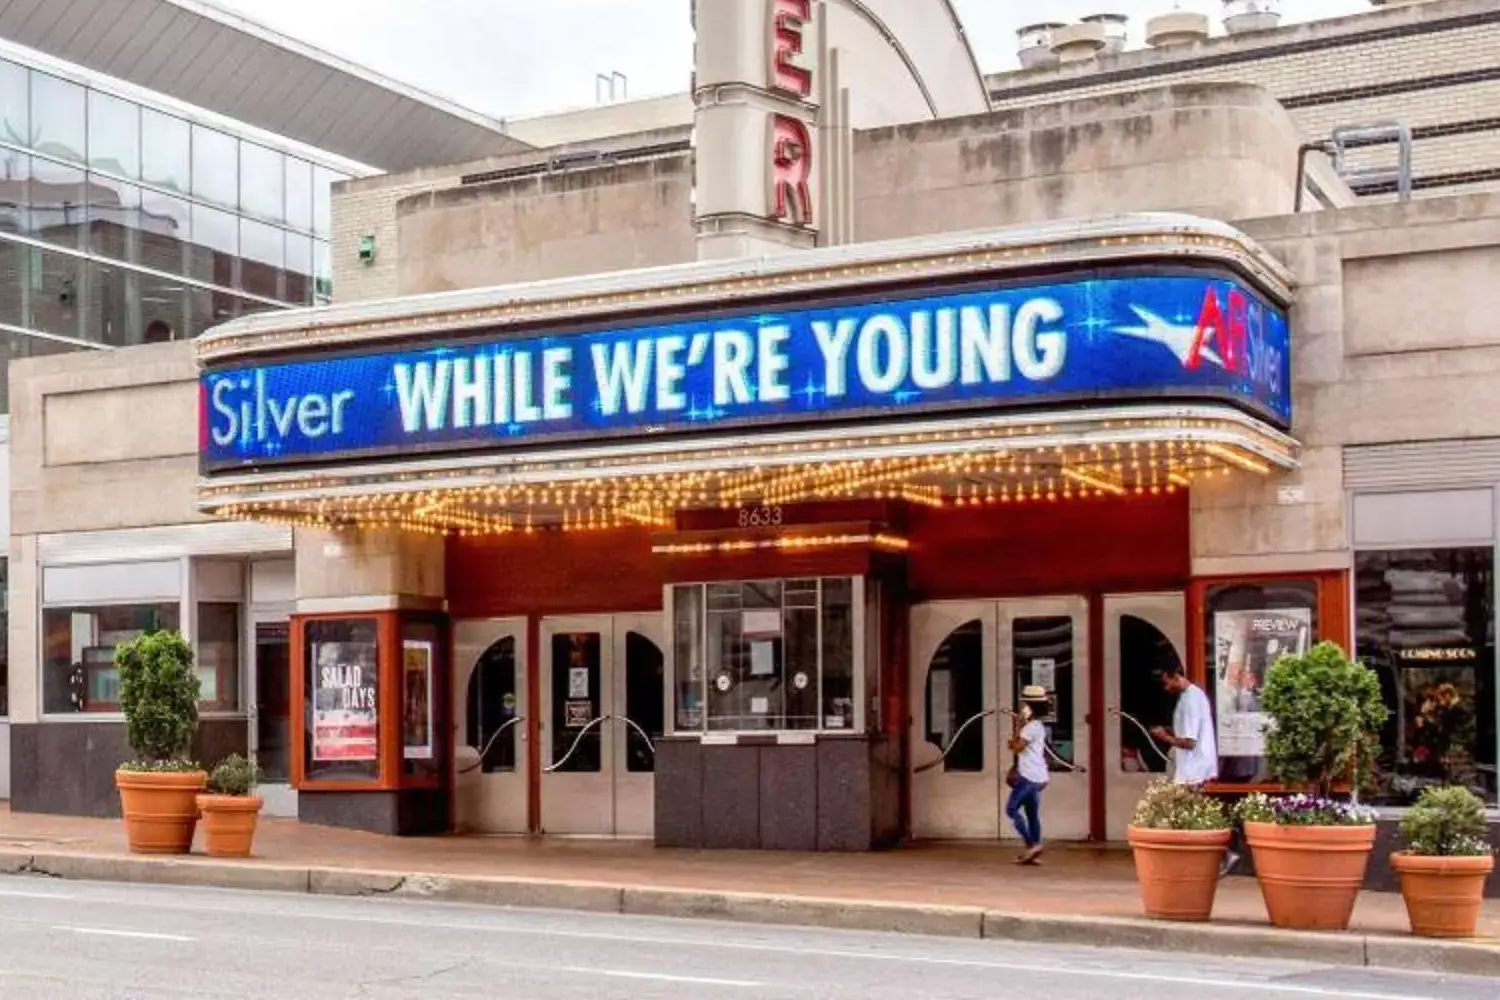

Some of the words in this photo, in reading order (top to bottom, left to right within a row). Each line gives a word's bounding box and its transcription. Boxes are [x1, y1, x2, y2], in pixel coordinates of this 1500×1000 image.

[395, 346, 574, 433] WHILE
[591, 325, 790, 416] WE'RE
[812, 298, 1067, 397] YOUNG
[212, 368, 354, 446] Silver
[739, 506, 782, 527] 8633
[321, 665, 361, 689] SALAD
[342, 686, 376, 709] DAYS
